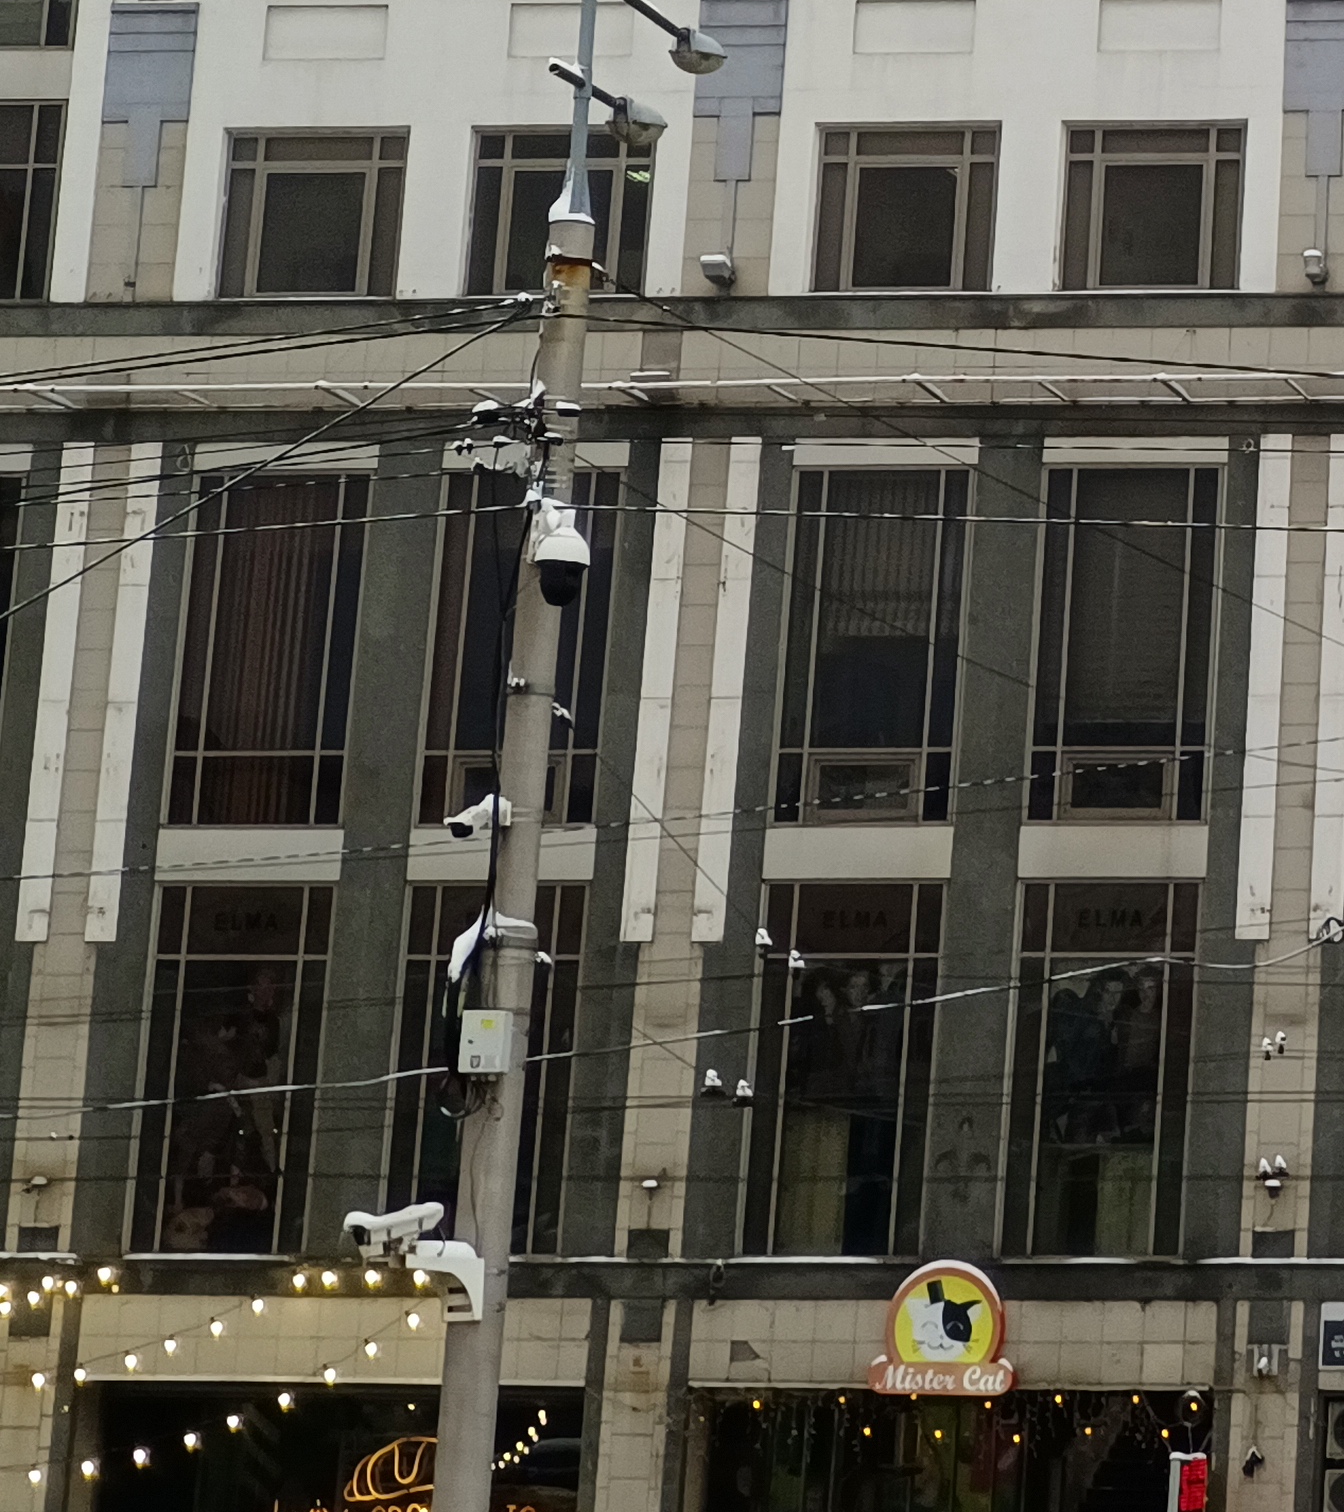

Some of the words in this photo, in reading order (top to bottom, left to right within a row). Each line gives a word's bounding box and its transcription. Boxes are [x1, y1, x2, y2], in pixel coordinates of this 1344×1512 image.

[214, 911, 278, 931] ELMA
[822, 910, 888, 929] ELMA
[1077, 908, 1144, 928] ELMA
[875, 1364, 956, 1390] Mister
[963, 1365, 1005, 1392] Cat
